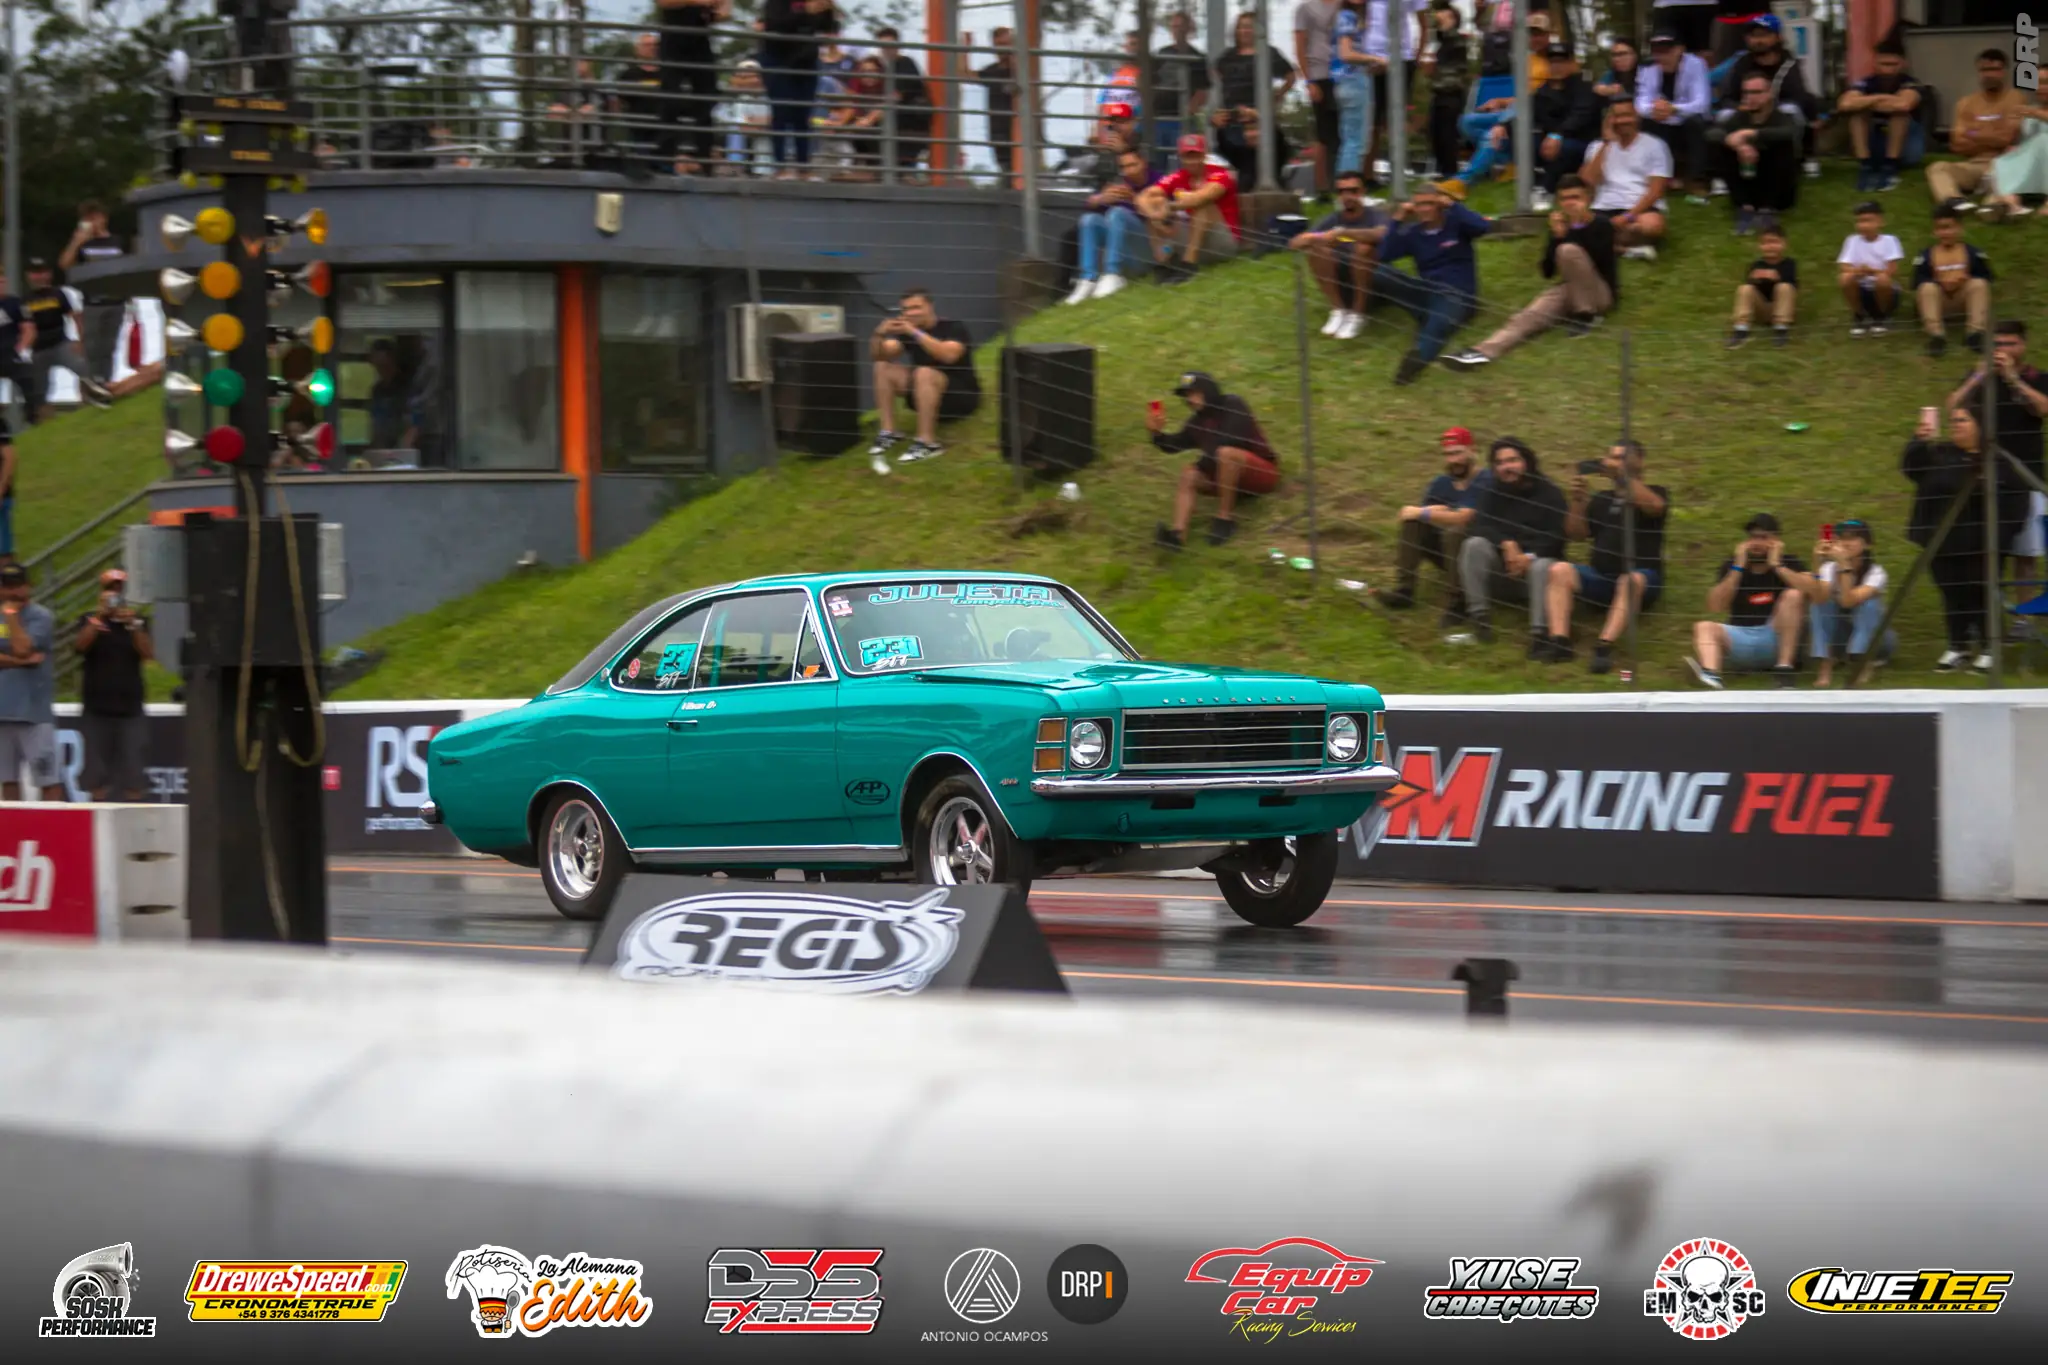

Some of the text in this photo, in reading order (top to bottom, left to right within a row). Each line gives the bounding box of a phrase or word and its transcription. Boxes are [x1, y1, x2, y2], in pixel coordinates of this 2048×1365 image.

[869, 583, 1052, 605] JULIETA
[1493, 768, 1731, 833] RACING
[1731, 772, 1894, 837] FUEL
